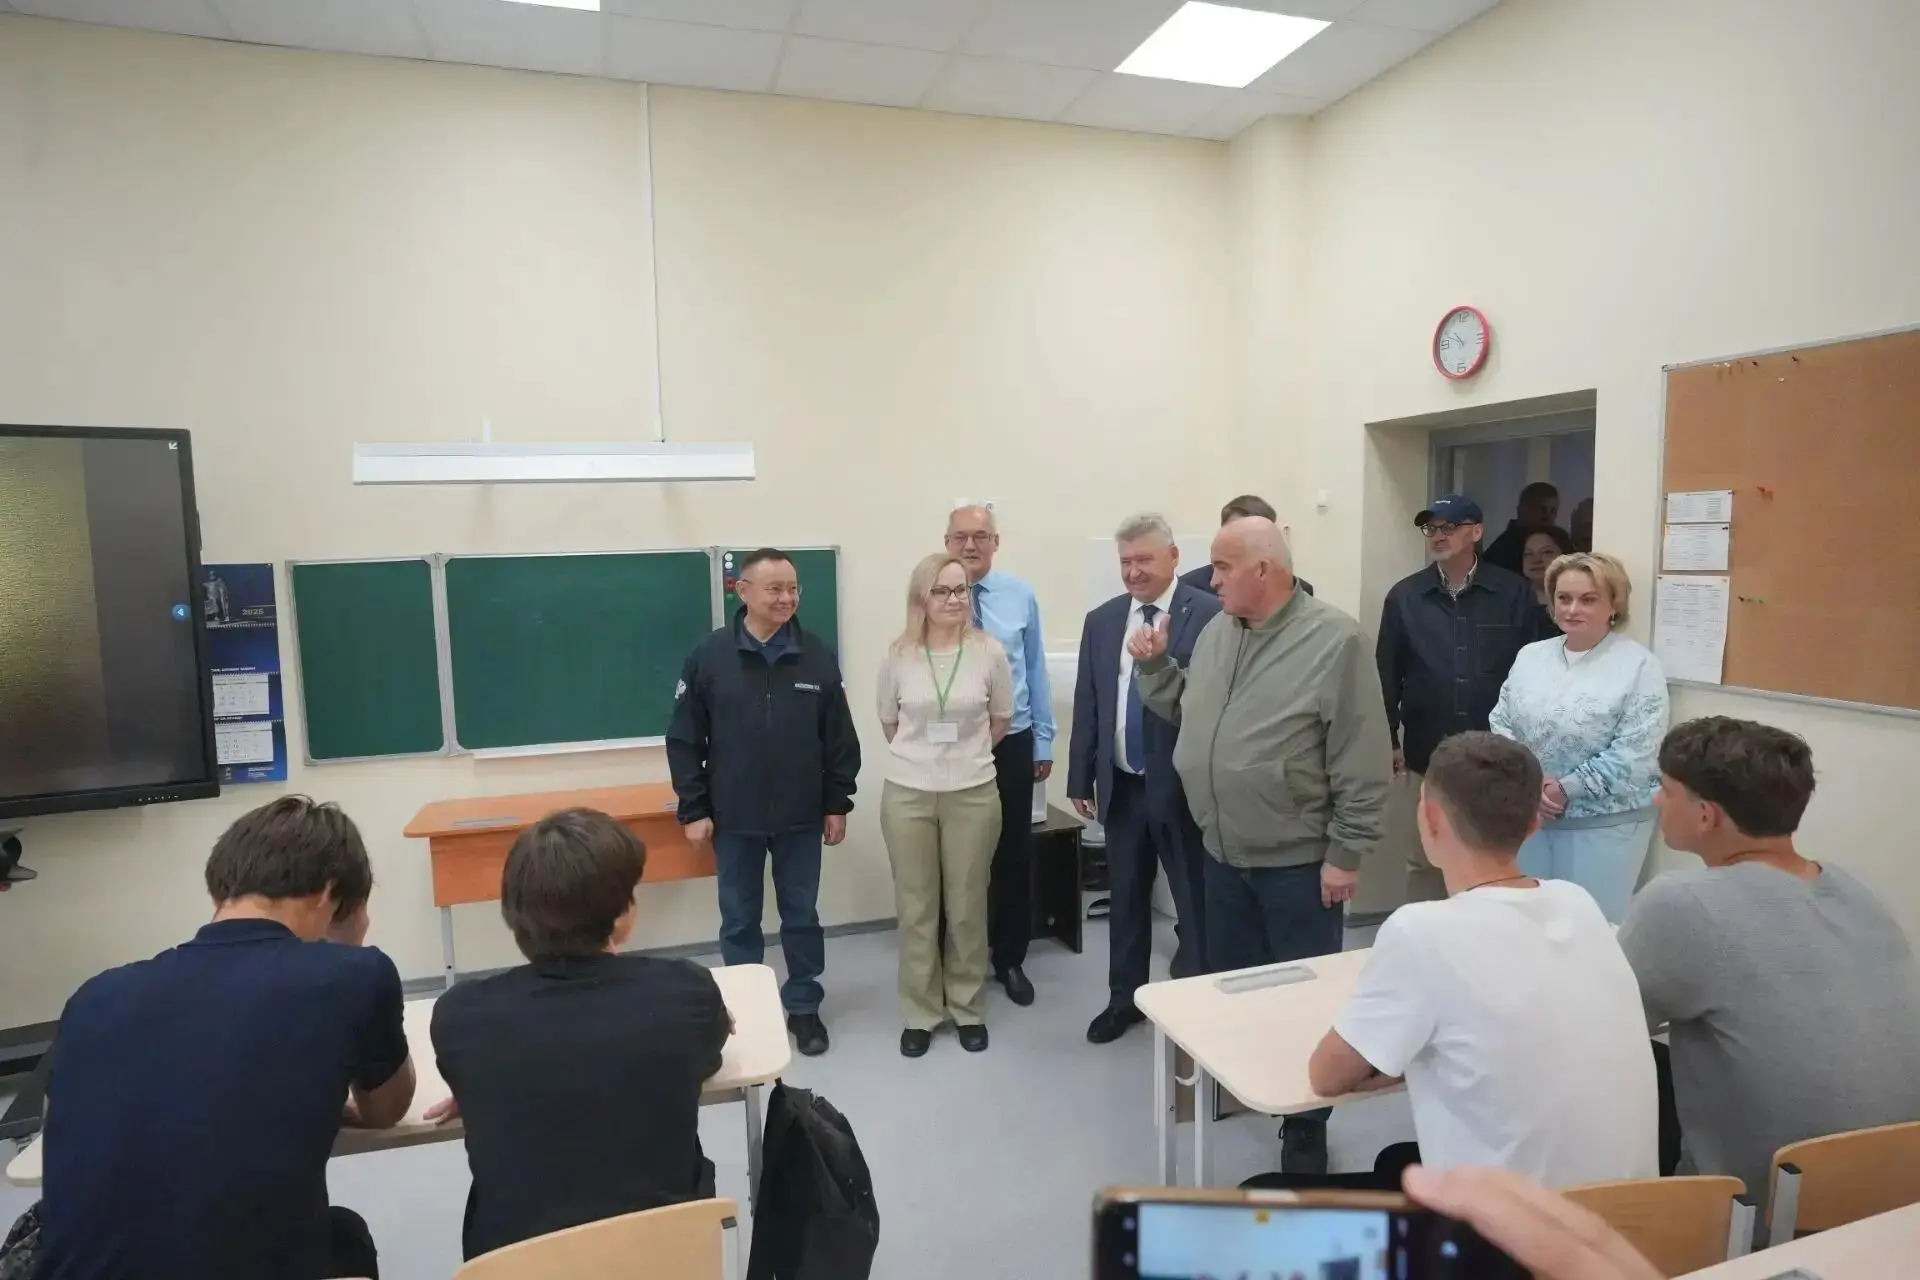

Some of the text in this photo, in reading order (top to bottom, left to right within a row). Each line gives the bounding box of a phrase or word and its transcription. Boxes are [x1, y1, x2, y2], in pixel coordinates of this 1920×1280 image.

[1459, 311, 1469, 322] 12
[1440, 340, 1450, 351] 9
[1457, 362, 1467, 373] 6
[241, 608, 265, 616] 2025
